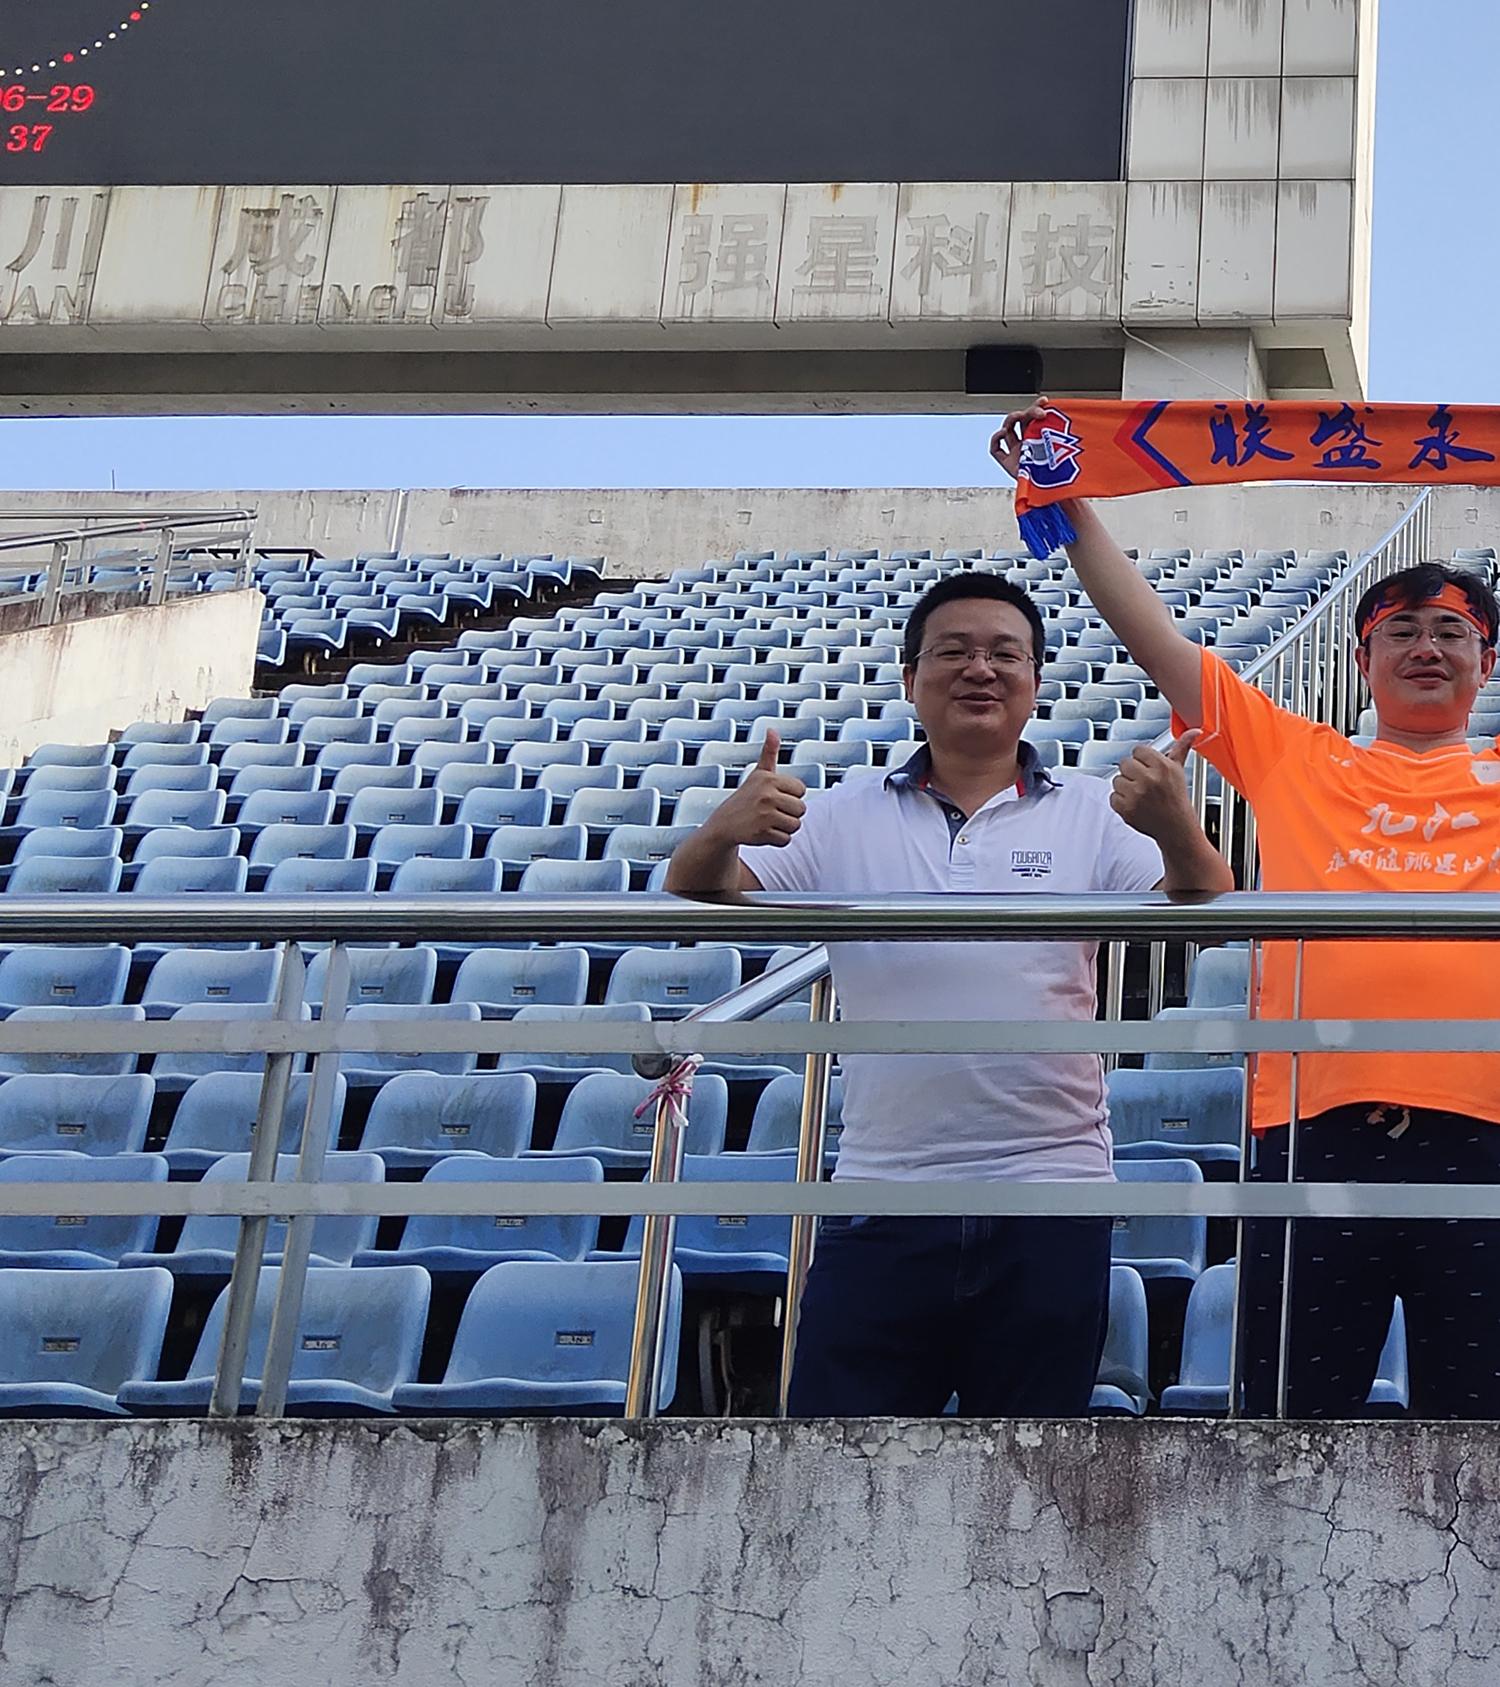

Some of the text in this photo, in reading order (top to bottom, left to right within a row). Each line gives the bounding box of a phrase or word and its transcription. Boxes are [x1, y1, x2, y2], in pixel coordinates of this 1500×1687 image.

[0, 84, 94, 111] 6-29
[680, 213, 1115, 297] 强星科技
[0, 285, 87, 320] AN
